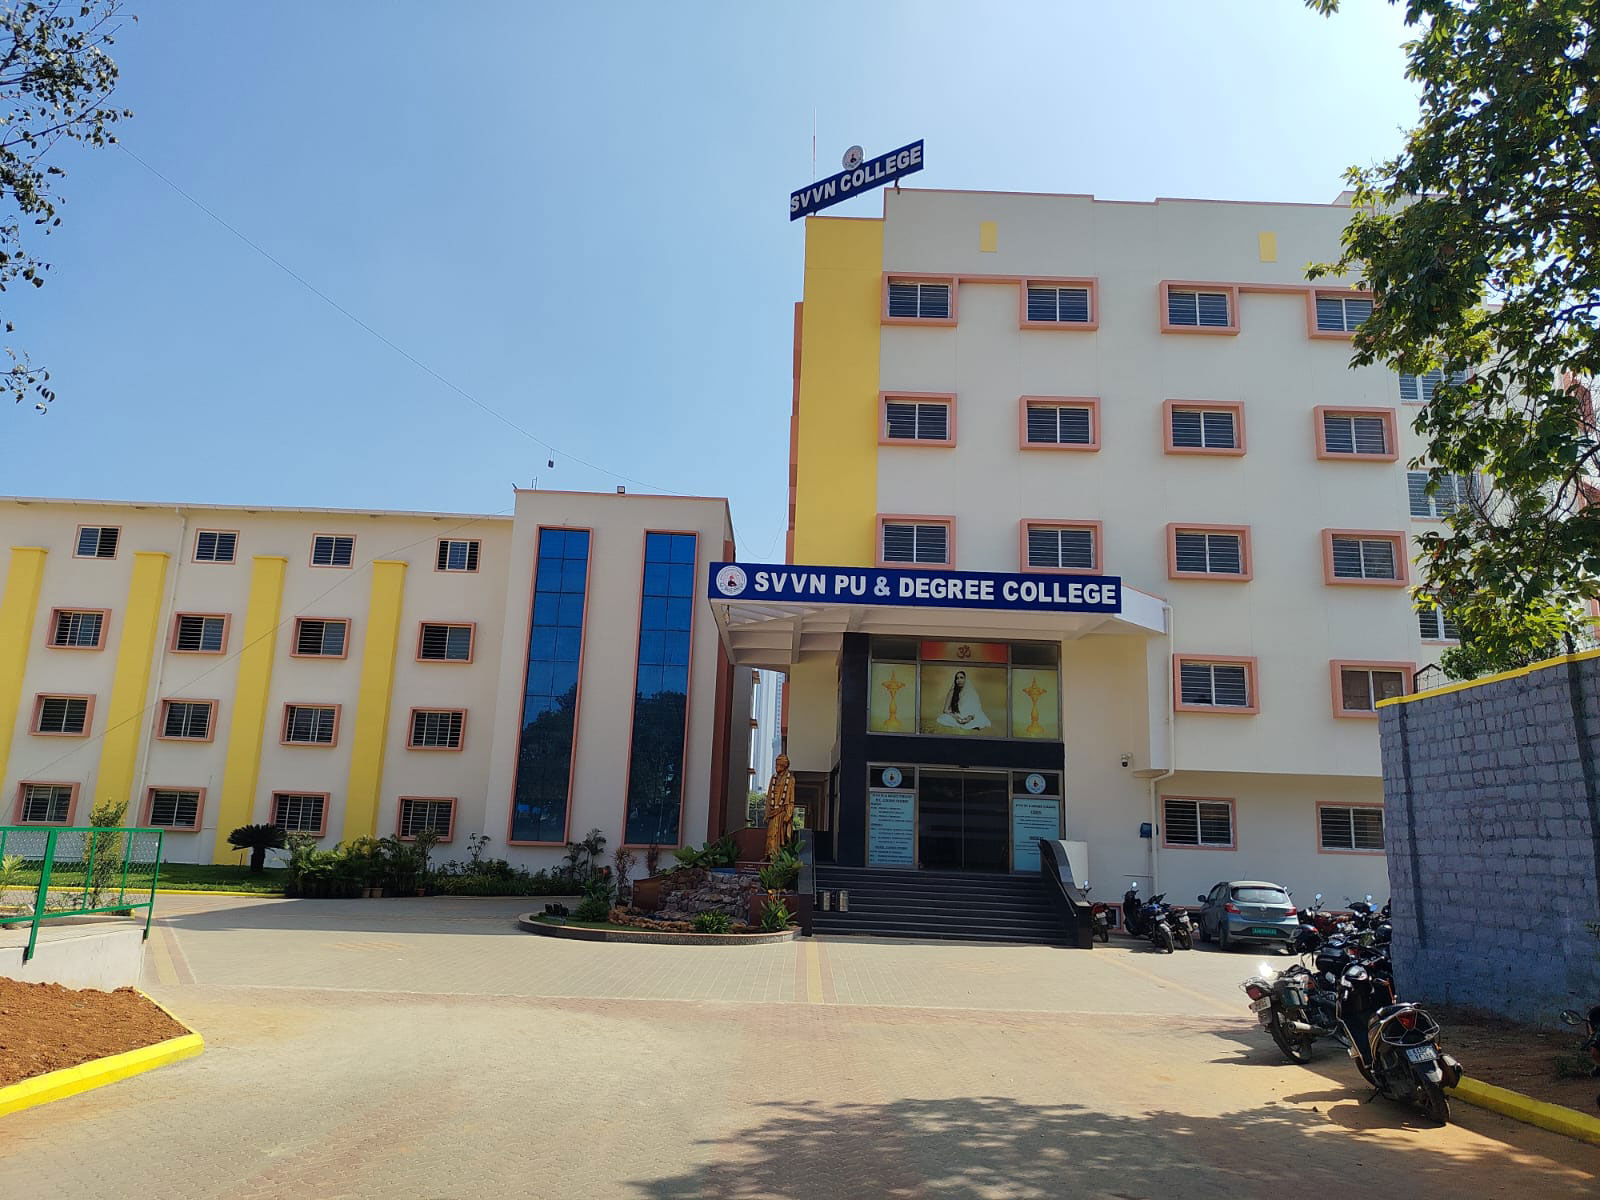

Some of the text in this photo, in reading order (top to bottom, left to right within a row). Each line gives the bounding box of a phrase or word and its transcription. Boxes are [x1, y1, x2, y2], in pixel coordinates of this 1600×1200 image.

[790, 180, 836, 212] SVVN
[840, 145, 922, 192] COLLEGE
[754, 571, 826, 594] SVVN
[834, 574, 867, 596] PU
[873, 576, 891, 597] &
[899, 577, 995, 600] DEGREE
[1002, 580, 1117, 605] COLLEGE
